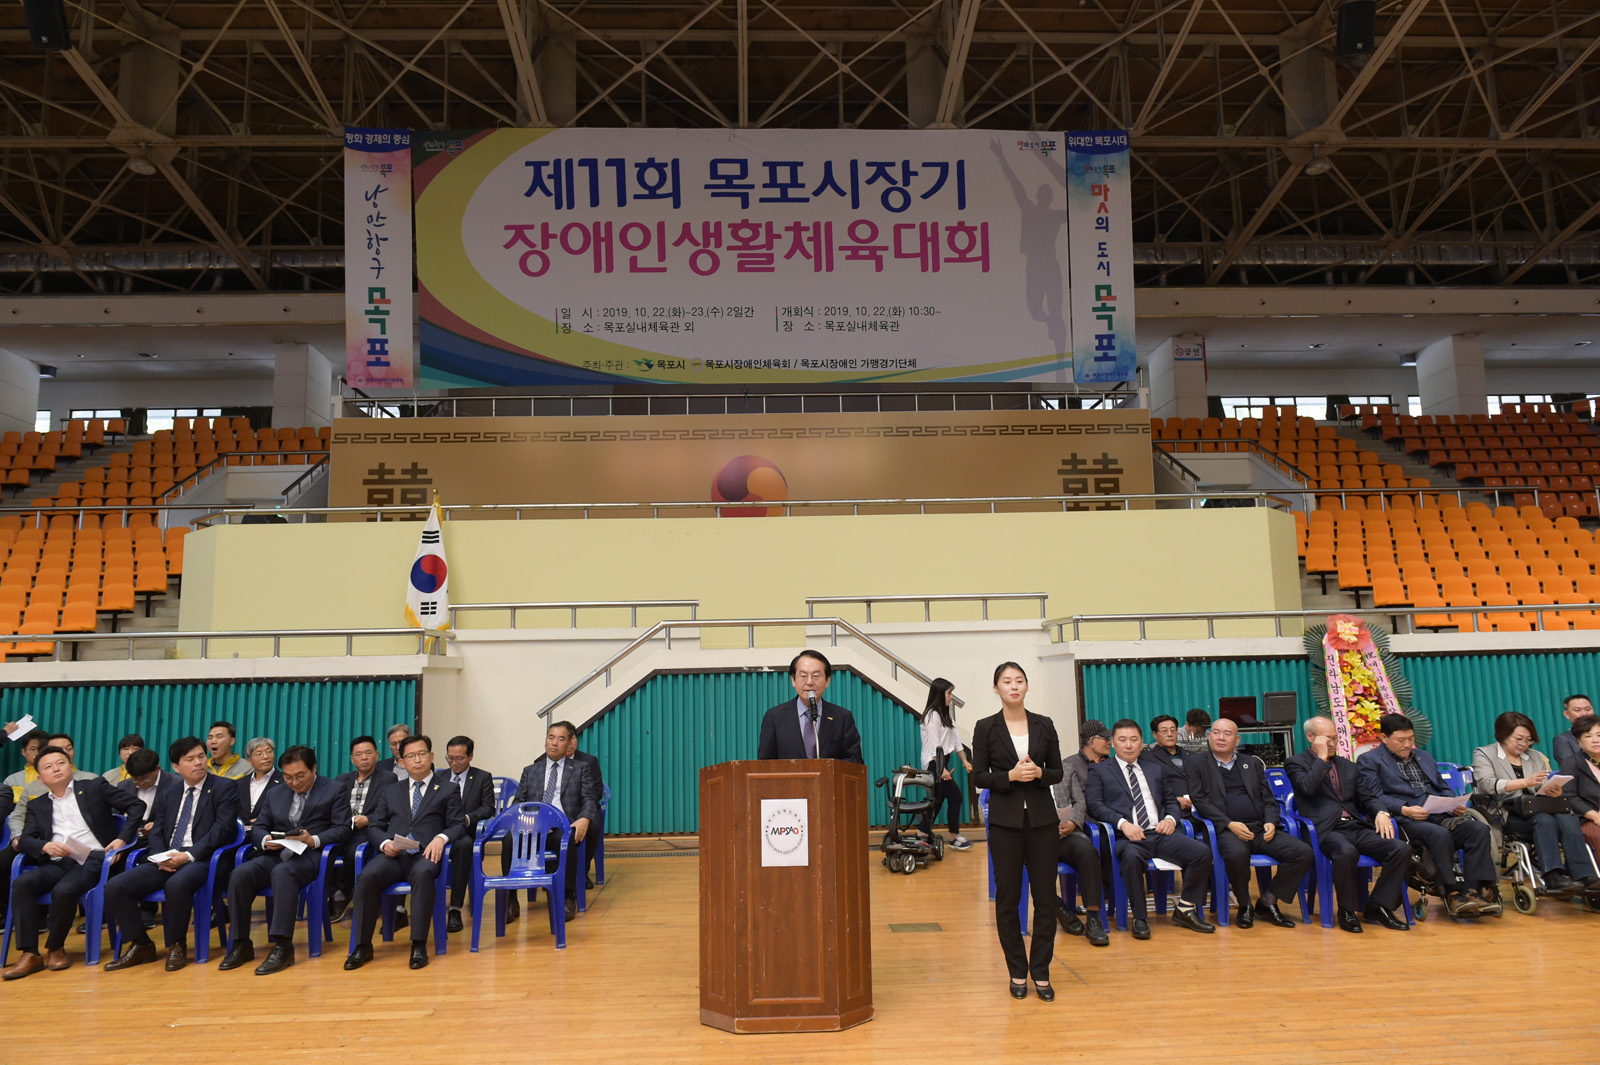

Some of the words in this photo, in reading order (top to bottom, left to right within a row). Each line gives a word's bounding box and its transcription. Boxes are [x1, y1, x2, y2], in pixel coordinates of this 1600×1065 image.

[345, 132, 363, 144] 평화
[364, 133, 391, 145] 경제의
[393, 133, 410, 145] 중심
[1068, 136, 1094, 147] 위대한
[1095, 135, 1128, 146] 목포시대
[446, 139, 465, 158] 목포
[1041, 140, 1056, 158] 목포
[523, 156, 682, 210] 제11회
[703, 157, 967, 213] 목포시장기
[1091, 183, 1111, 233] 맛의
[502, 218, 991, 278] 장애인생활체육대회
[1096, 241, 1112, 277] 도시
[602, 307, 631, 319] 2019.
[634, 307, 650, 319] 10.
[727, 305, 755, 318] 2일간
[781, 305, 815, 317] 개회식
[824, 306, 852, 318] 2019.
[855, 306, 870, 318] 10.
[873, 305, 906, 318] 22.(화)
[909, 305, 942, 317] 10:30~
[364, 286, 392, 368] 목포
[603, 321, 680, 334] 목포실내체육관
[684, 321, 695, 333] 외
[824, 320, 900, 332] 목포실내체육관
[1092, 284, 1118, 363] 목포
[656, 359, 686, 370] 목포시
[704, 358, 791, 370] 목포시장애인체육회
[799, 358, 858, 369] 목포시장애인
[860, 358, 917, 369] 가맹경기단체
